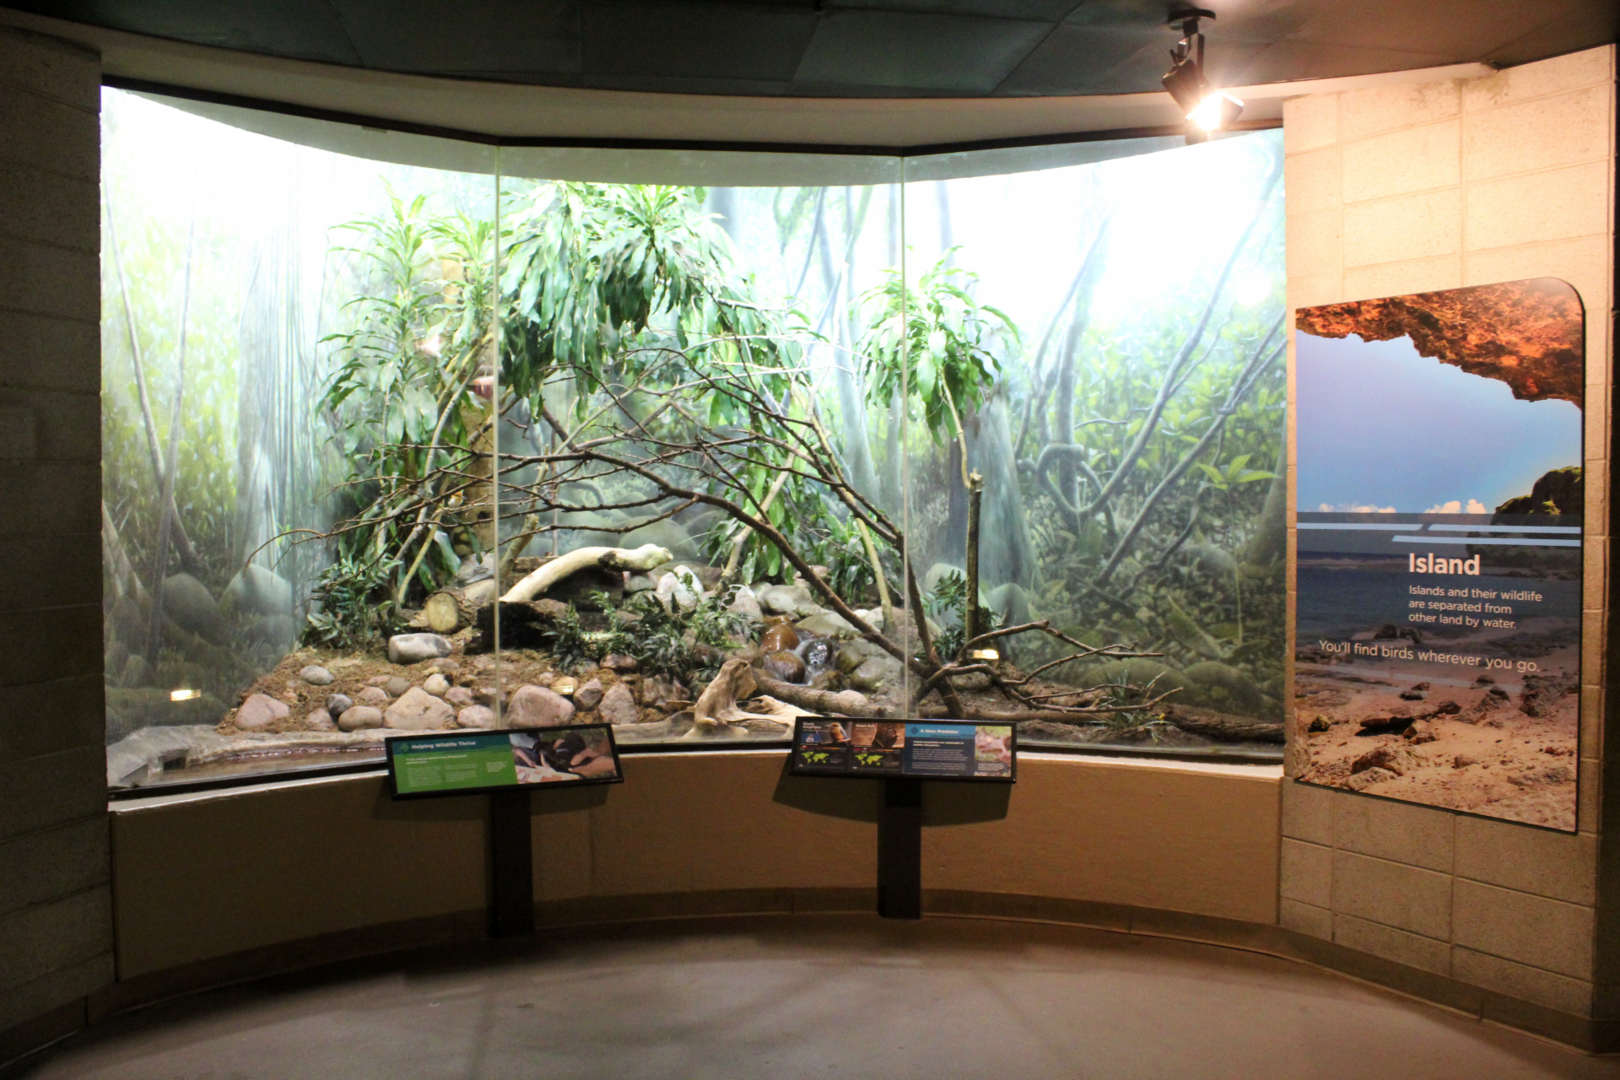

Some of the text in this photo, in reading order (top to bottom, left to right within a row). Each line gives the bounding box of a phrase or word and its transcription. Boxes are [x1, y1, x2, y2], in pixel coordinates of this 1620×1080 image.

[1409, 552, 1480, 575] Island
[1409, 585, 1543, 602] Islands and their wildlife
[1408, 600, 1512, 614] are separated from
[1408, 613, 1517, 629] other land by water.
[1319, 640, 1540, 673] You'll find birds wherever you go.
